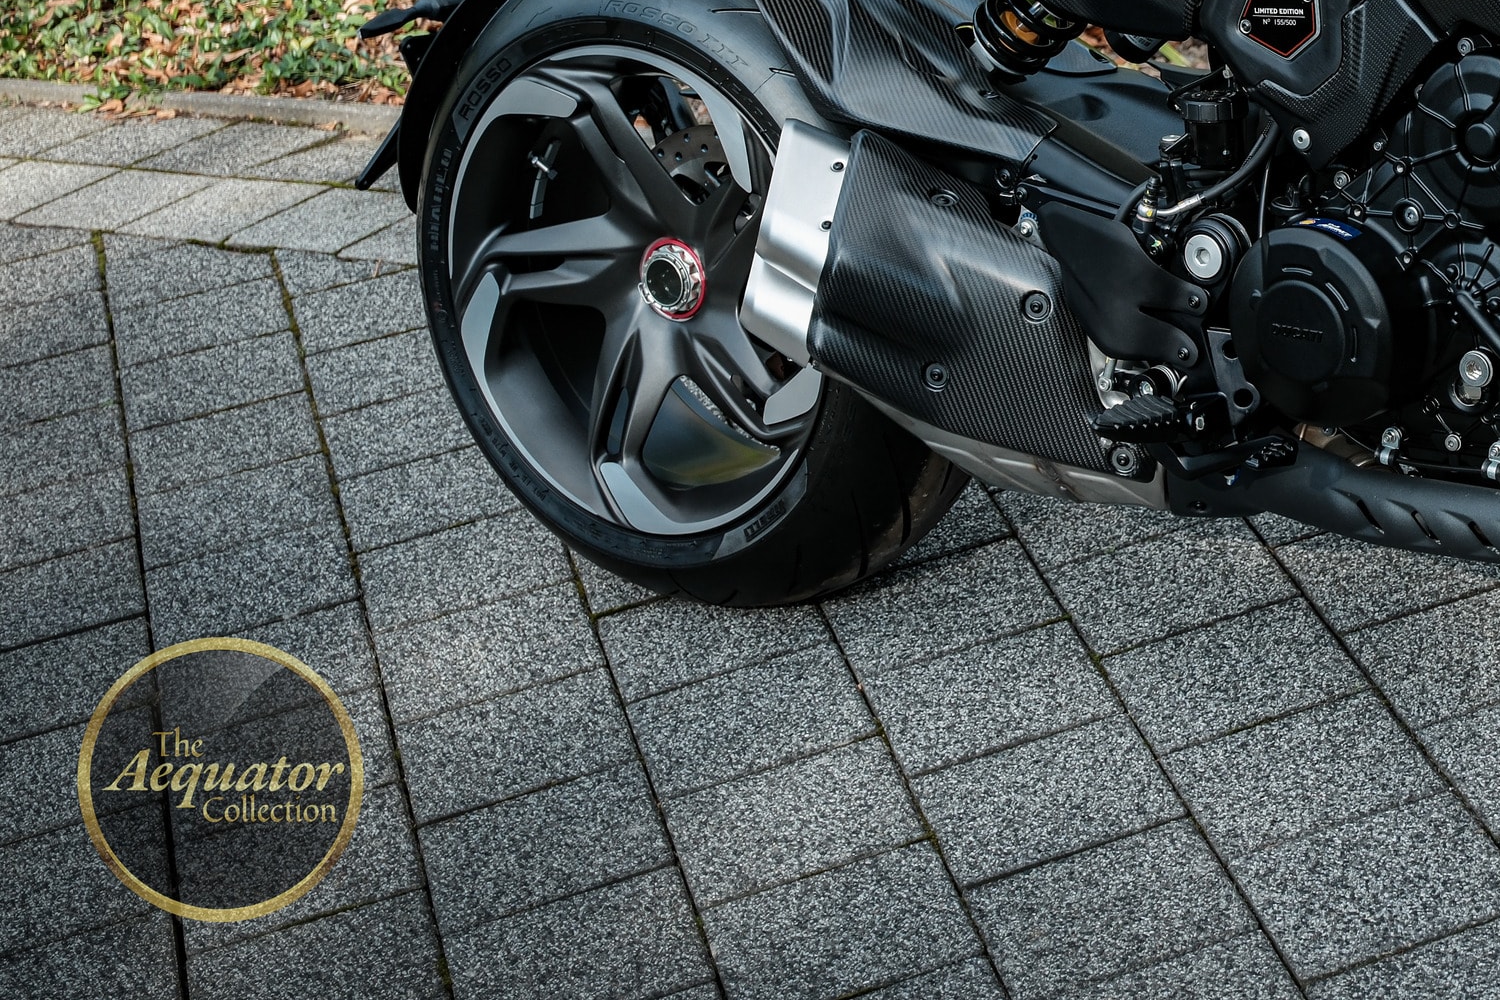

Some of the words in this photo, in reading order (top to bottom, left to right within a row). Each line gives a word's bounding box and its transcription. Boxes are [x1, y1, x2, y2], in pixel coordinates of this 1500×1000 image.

[604, 0, 698, 35] ROSSO
[1253, 7, 1278, 15] LIMITED
[1273, 18, 1297, 26] 155/500
[456, 54, 512, 121] ROSSO
